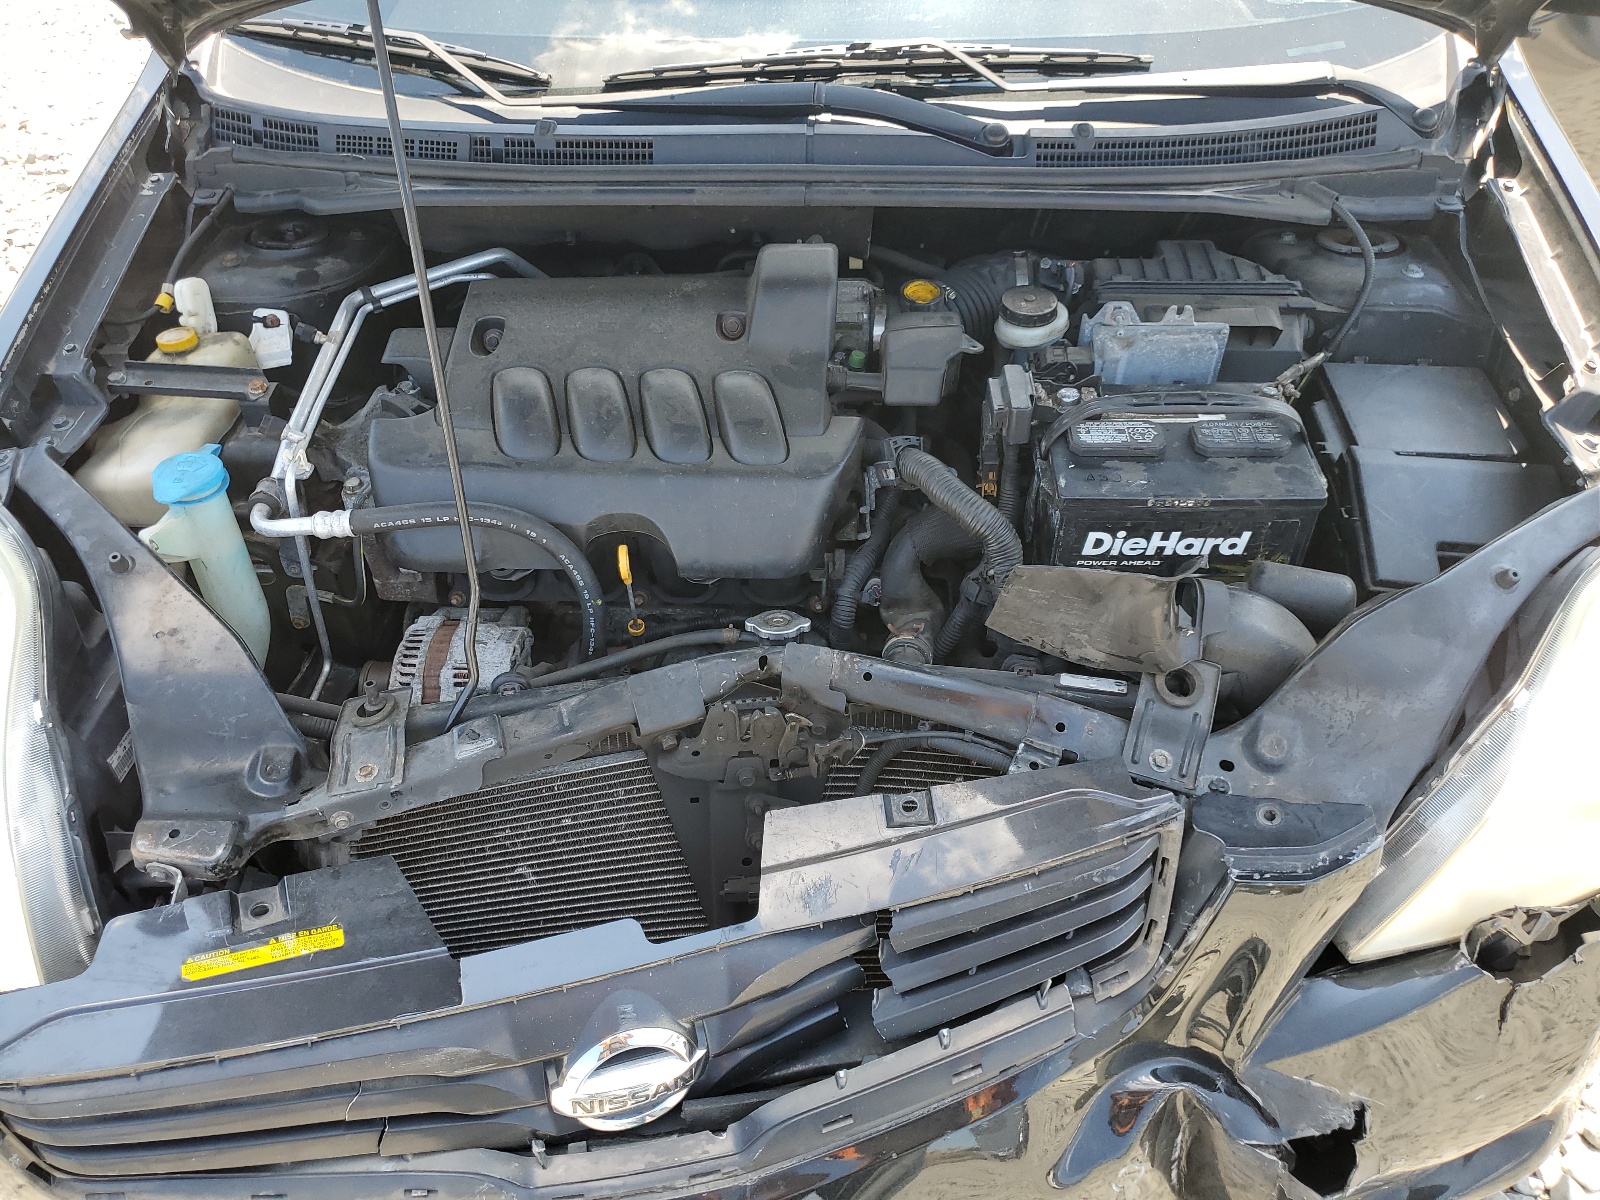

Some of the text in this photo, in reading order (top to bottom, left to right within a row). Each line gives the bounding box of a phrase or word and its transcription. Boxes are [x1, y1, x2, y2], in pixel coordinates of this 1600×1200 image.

[1081, 530, 1253, 556] DieHard
[277, 924, 339, 943] MISE EN GARDE
[194, 949, 231, 962] CAUTION
[570, 1066, 696, 1114] NISSAN
